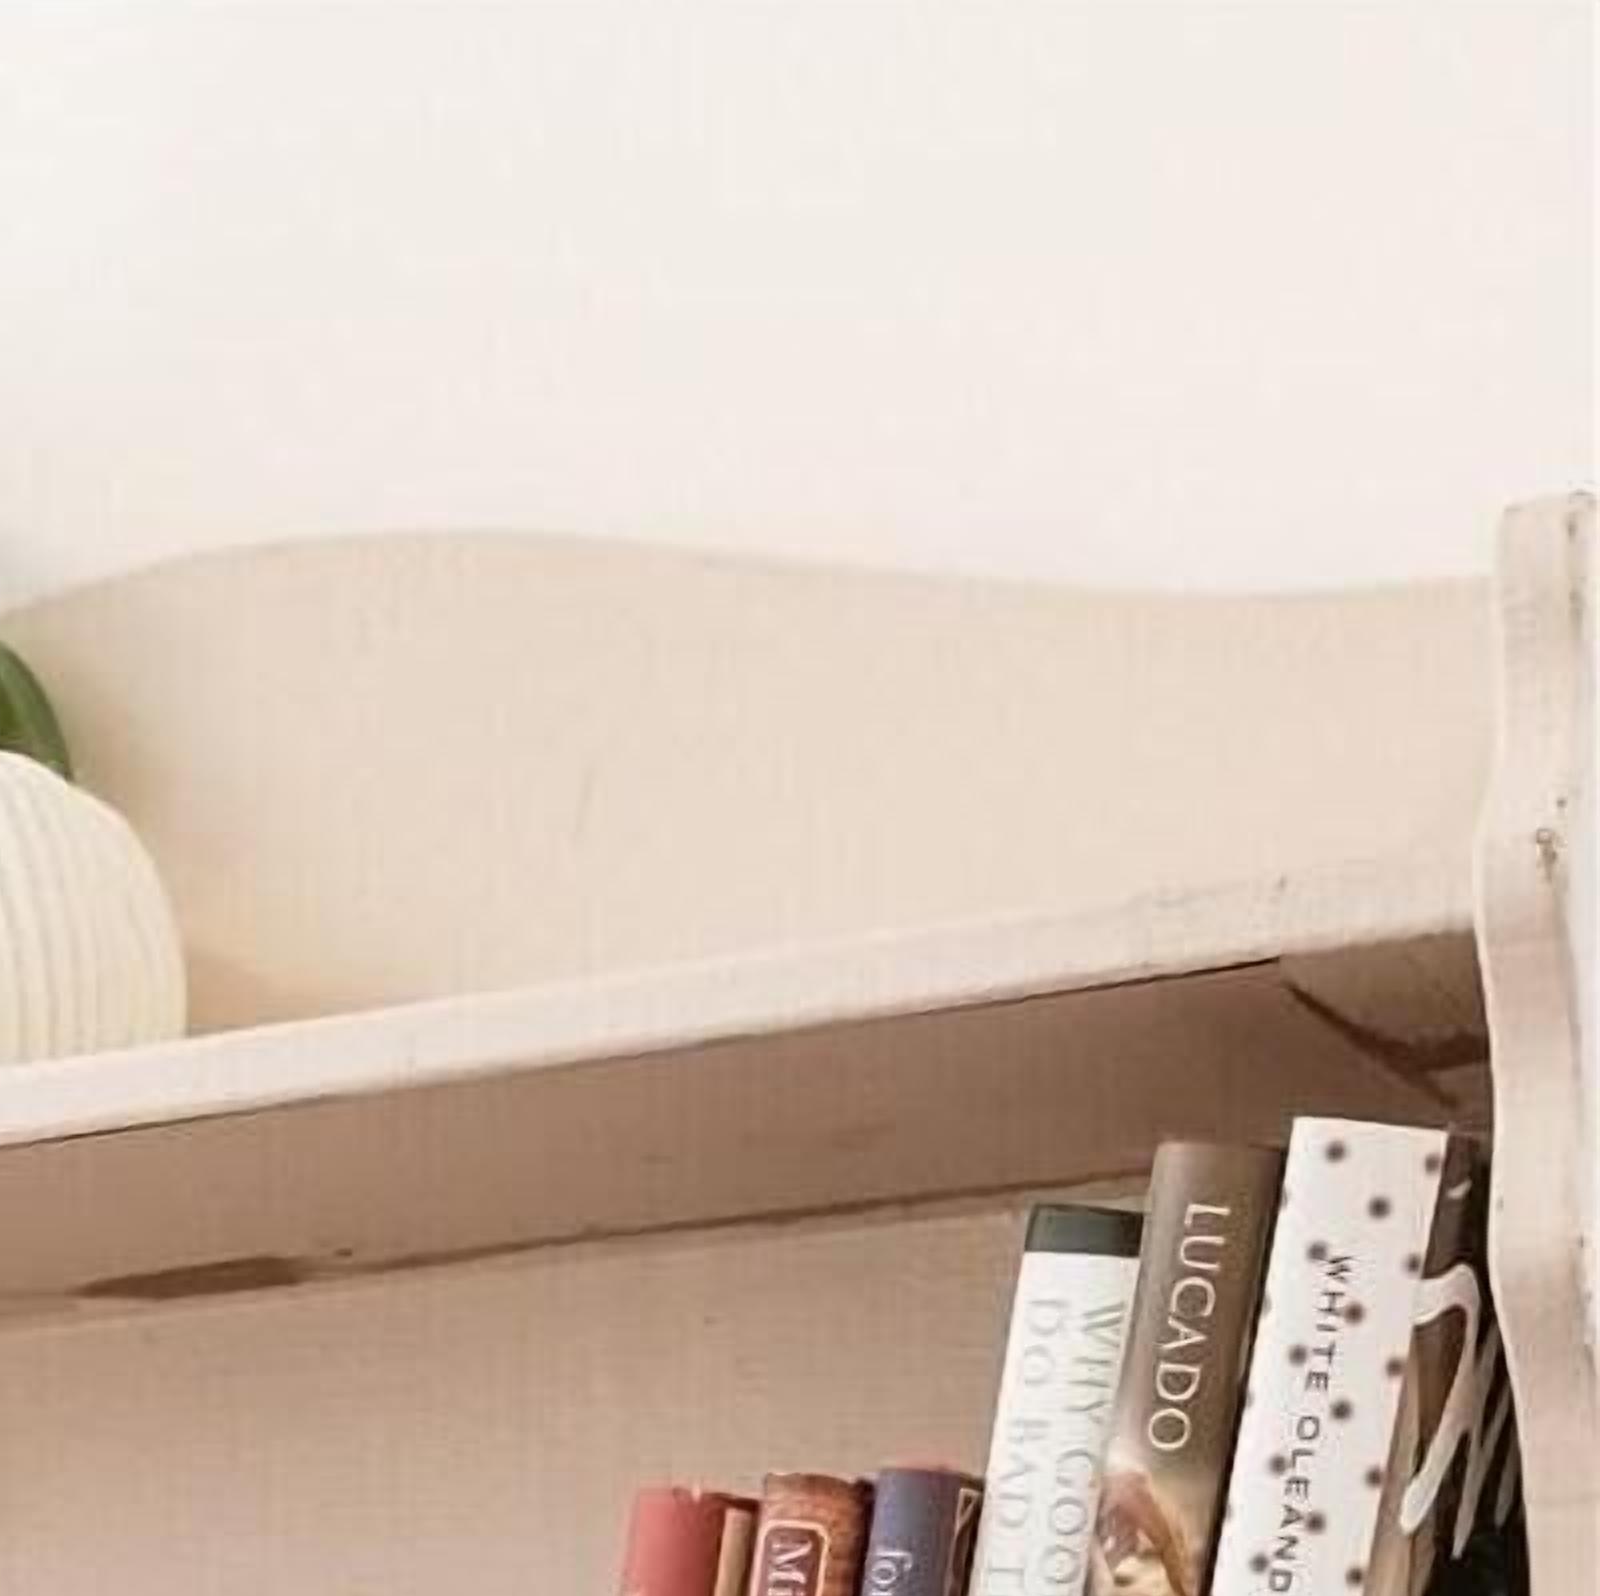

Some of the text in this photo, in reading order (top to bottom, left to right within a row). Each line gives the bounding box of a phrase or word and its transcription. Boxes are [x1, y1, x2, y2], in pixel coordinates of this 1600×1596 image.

[1020, 1295, 1068, 1390] DO
[1066, 1297, 1127, 1429] WHY
[1146, 1201, 1233, 1454] LUCADO
[1301, 1252, 1351, 1394] WHITE
[995, 1417, 1050, 1534] BAD
